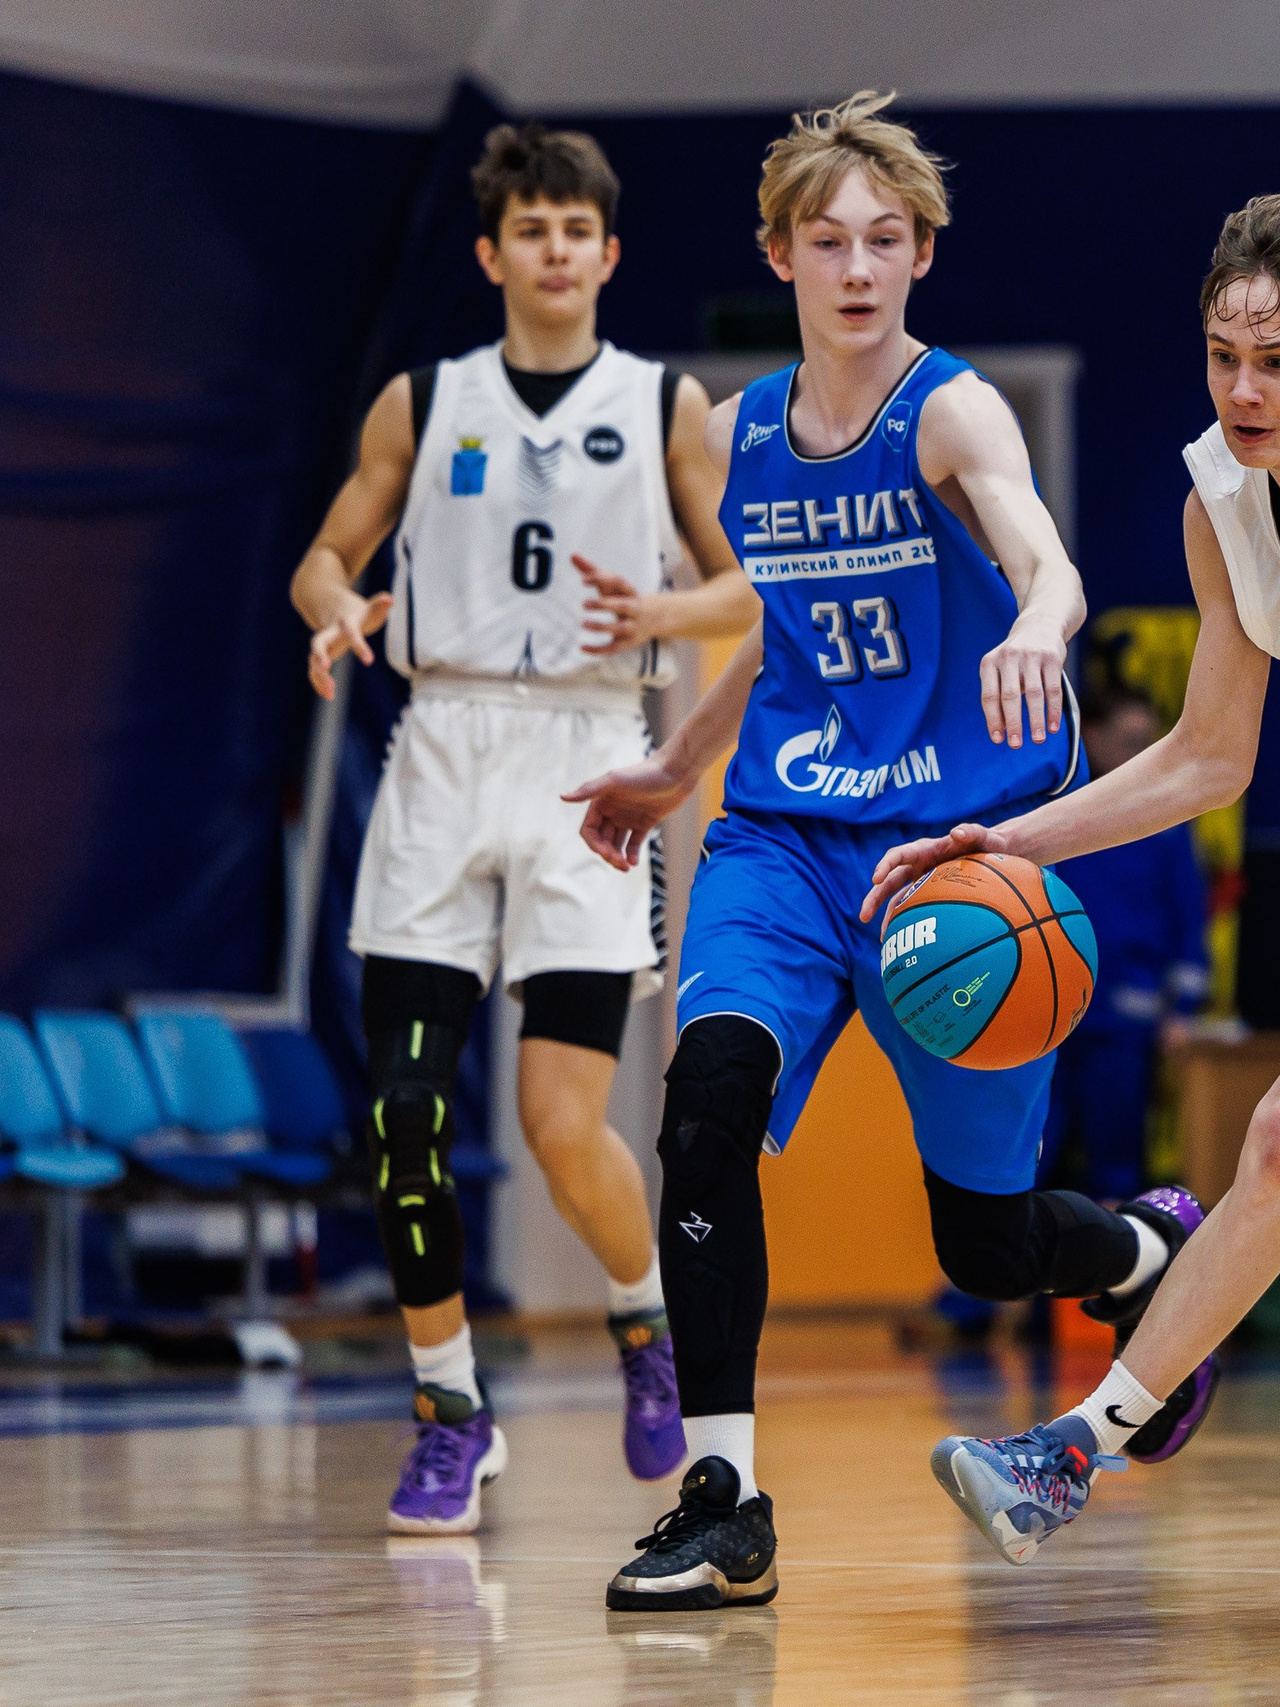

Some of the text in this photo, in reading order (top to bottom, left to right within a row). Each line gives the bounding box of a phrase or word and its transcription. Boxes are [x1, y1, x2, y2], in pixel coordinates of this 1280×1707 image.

[743, 488, 923, 548] ЗЕНИТ
[512, 519, 554, 593] 6
[755, 556, 839, 576] КУИНСКИЙ
[846, 550, 903, 569] ОЛИМП
[811, 597, 905, 681] 33
[924, 983, 951, 1008] PLASTIC
